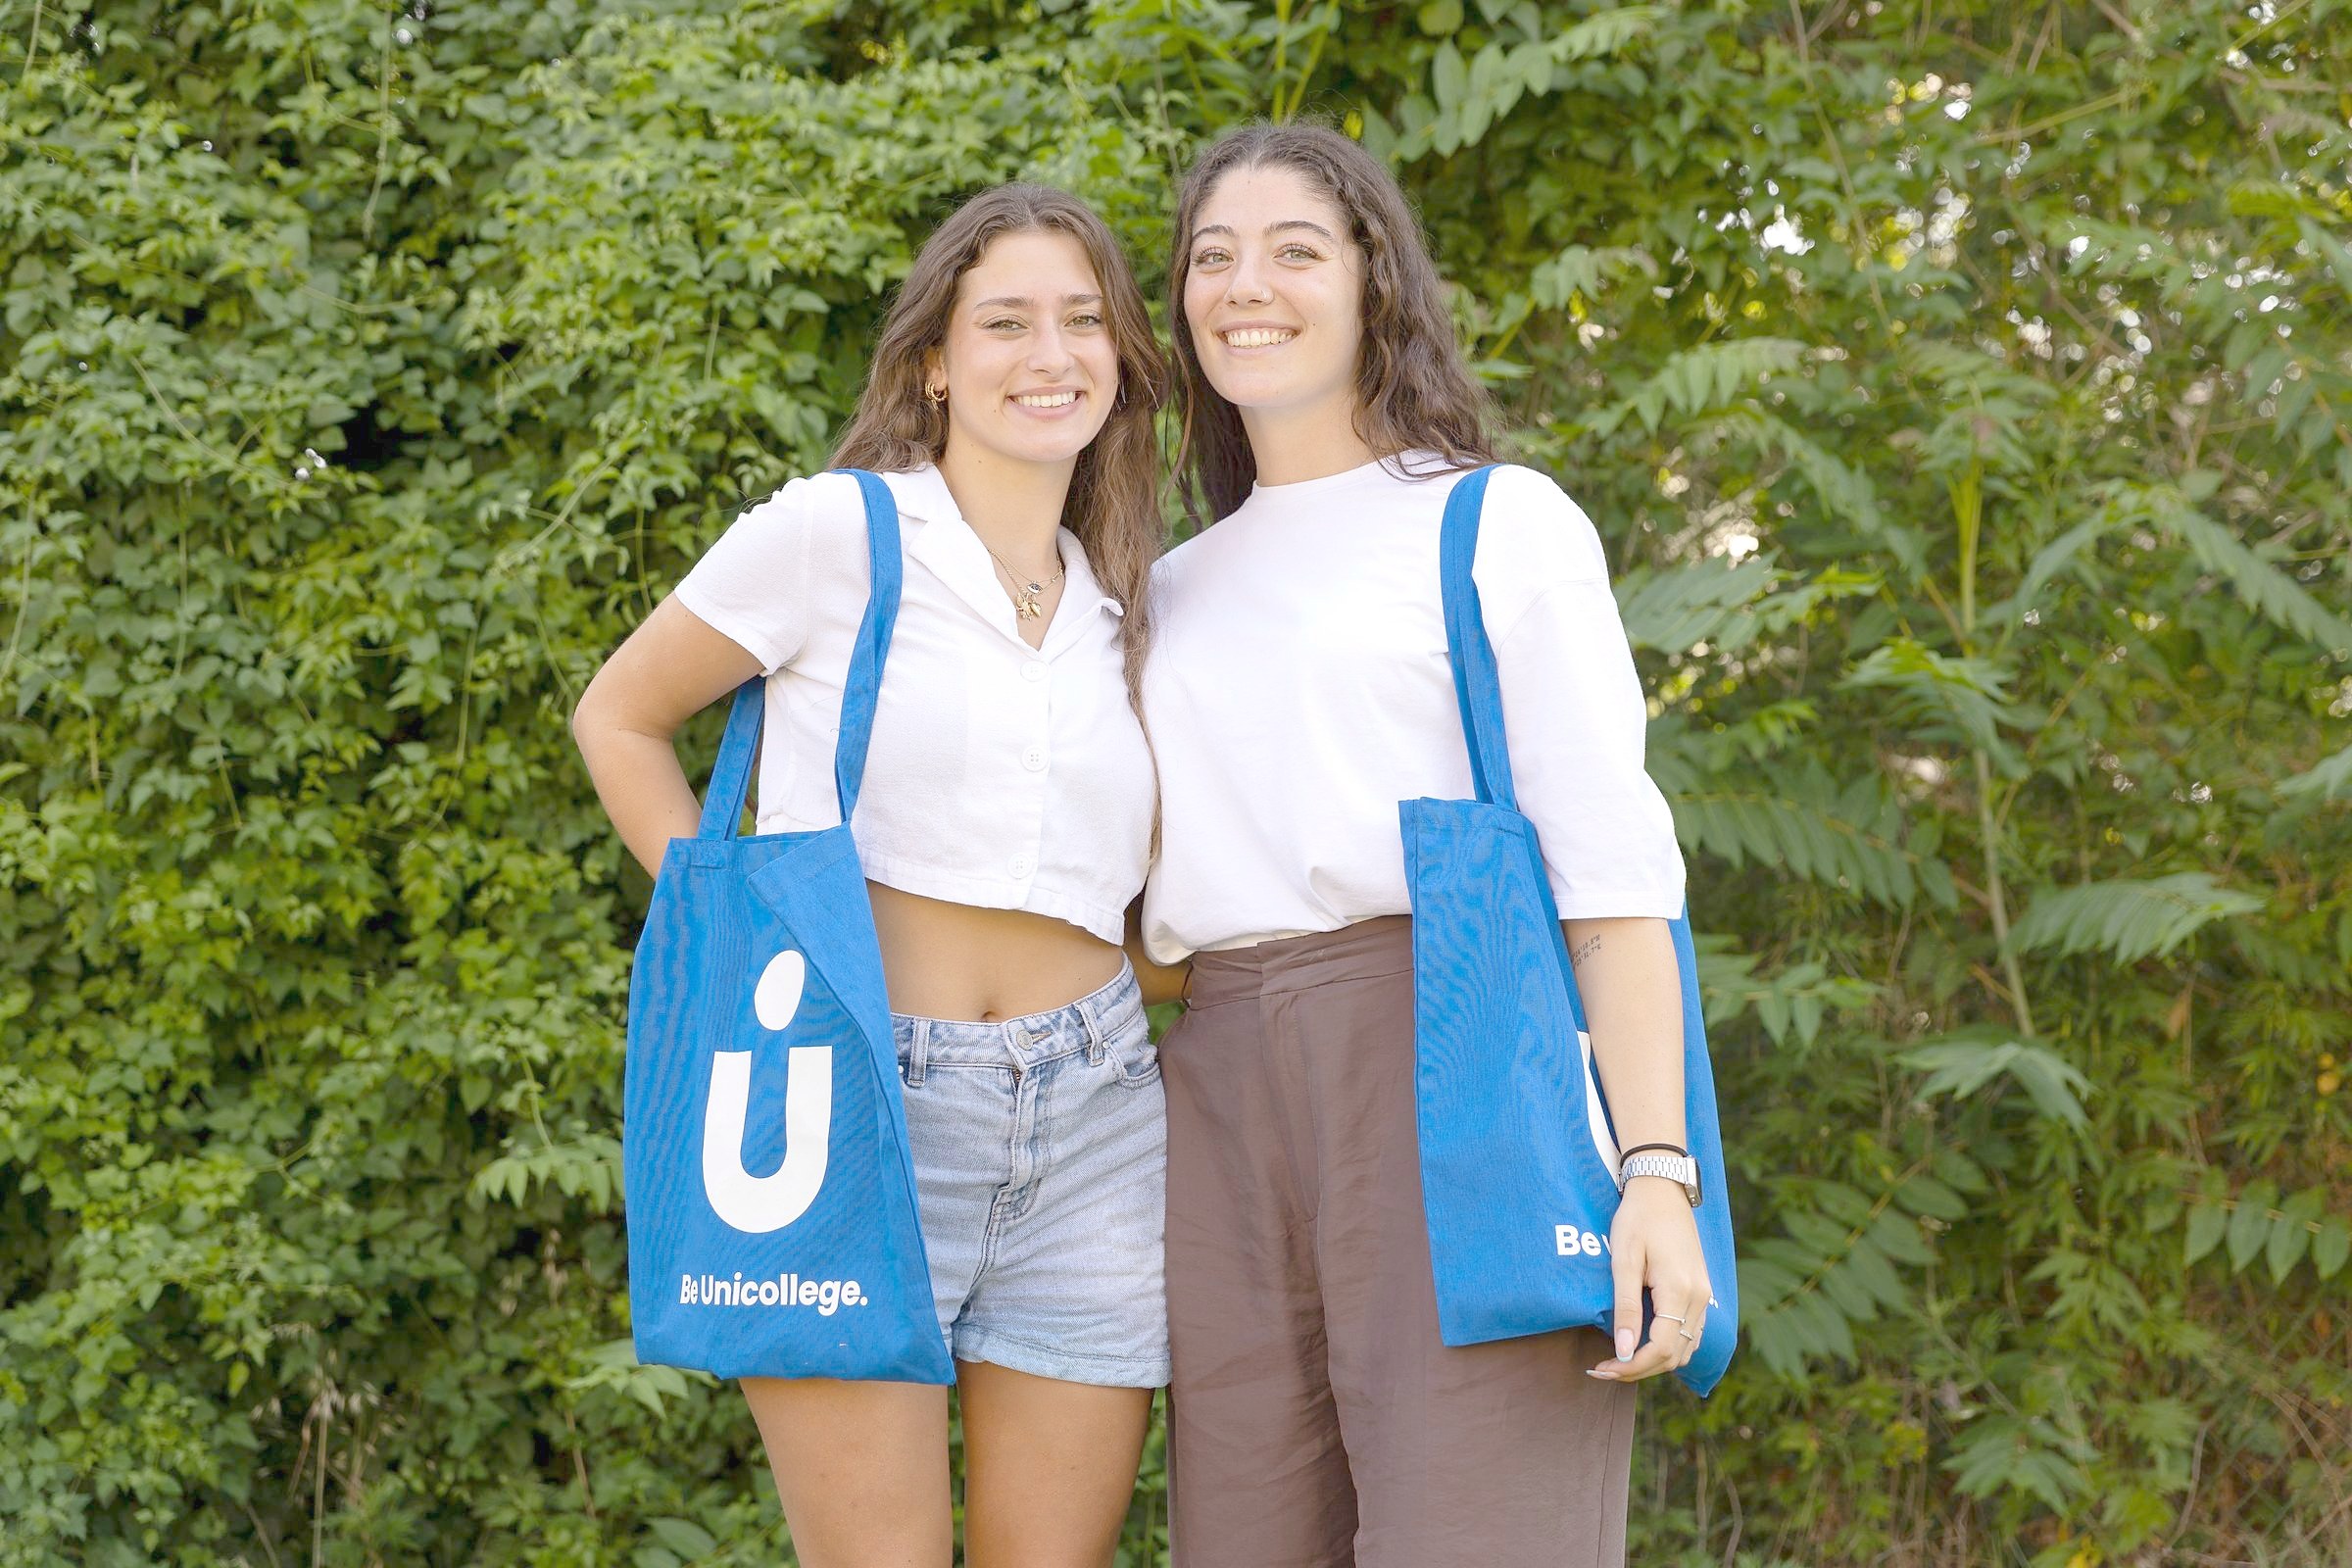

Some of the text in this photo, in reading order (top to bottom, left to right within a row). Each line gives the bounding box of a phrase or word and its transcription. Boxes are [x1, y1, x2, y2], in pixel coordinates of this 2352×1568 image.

[1554, 1224, 1602, 1256] Be
[679, 1271, 868, 1317] Be Unicollege.
